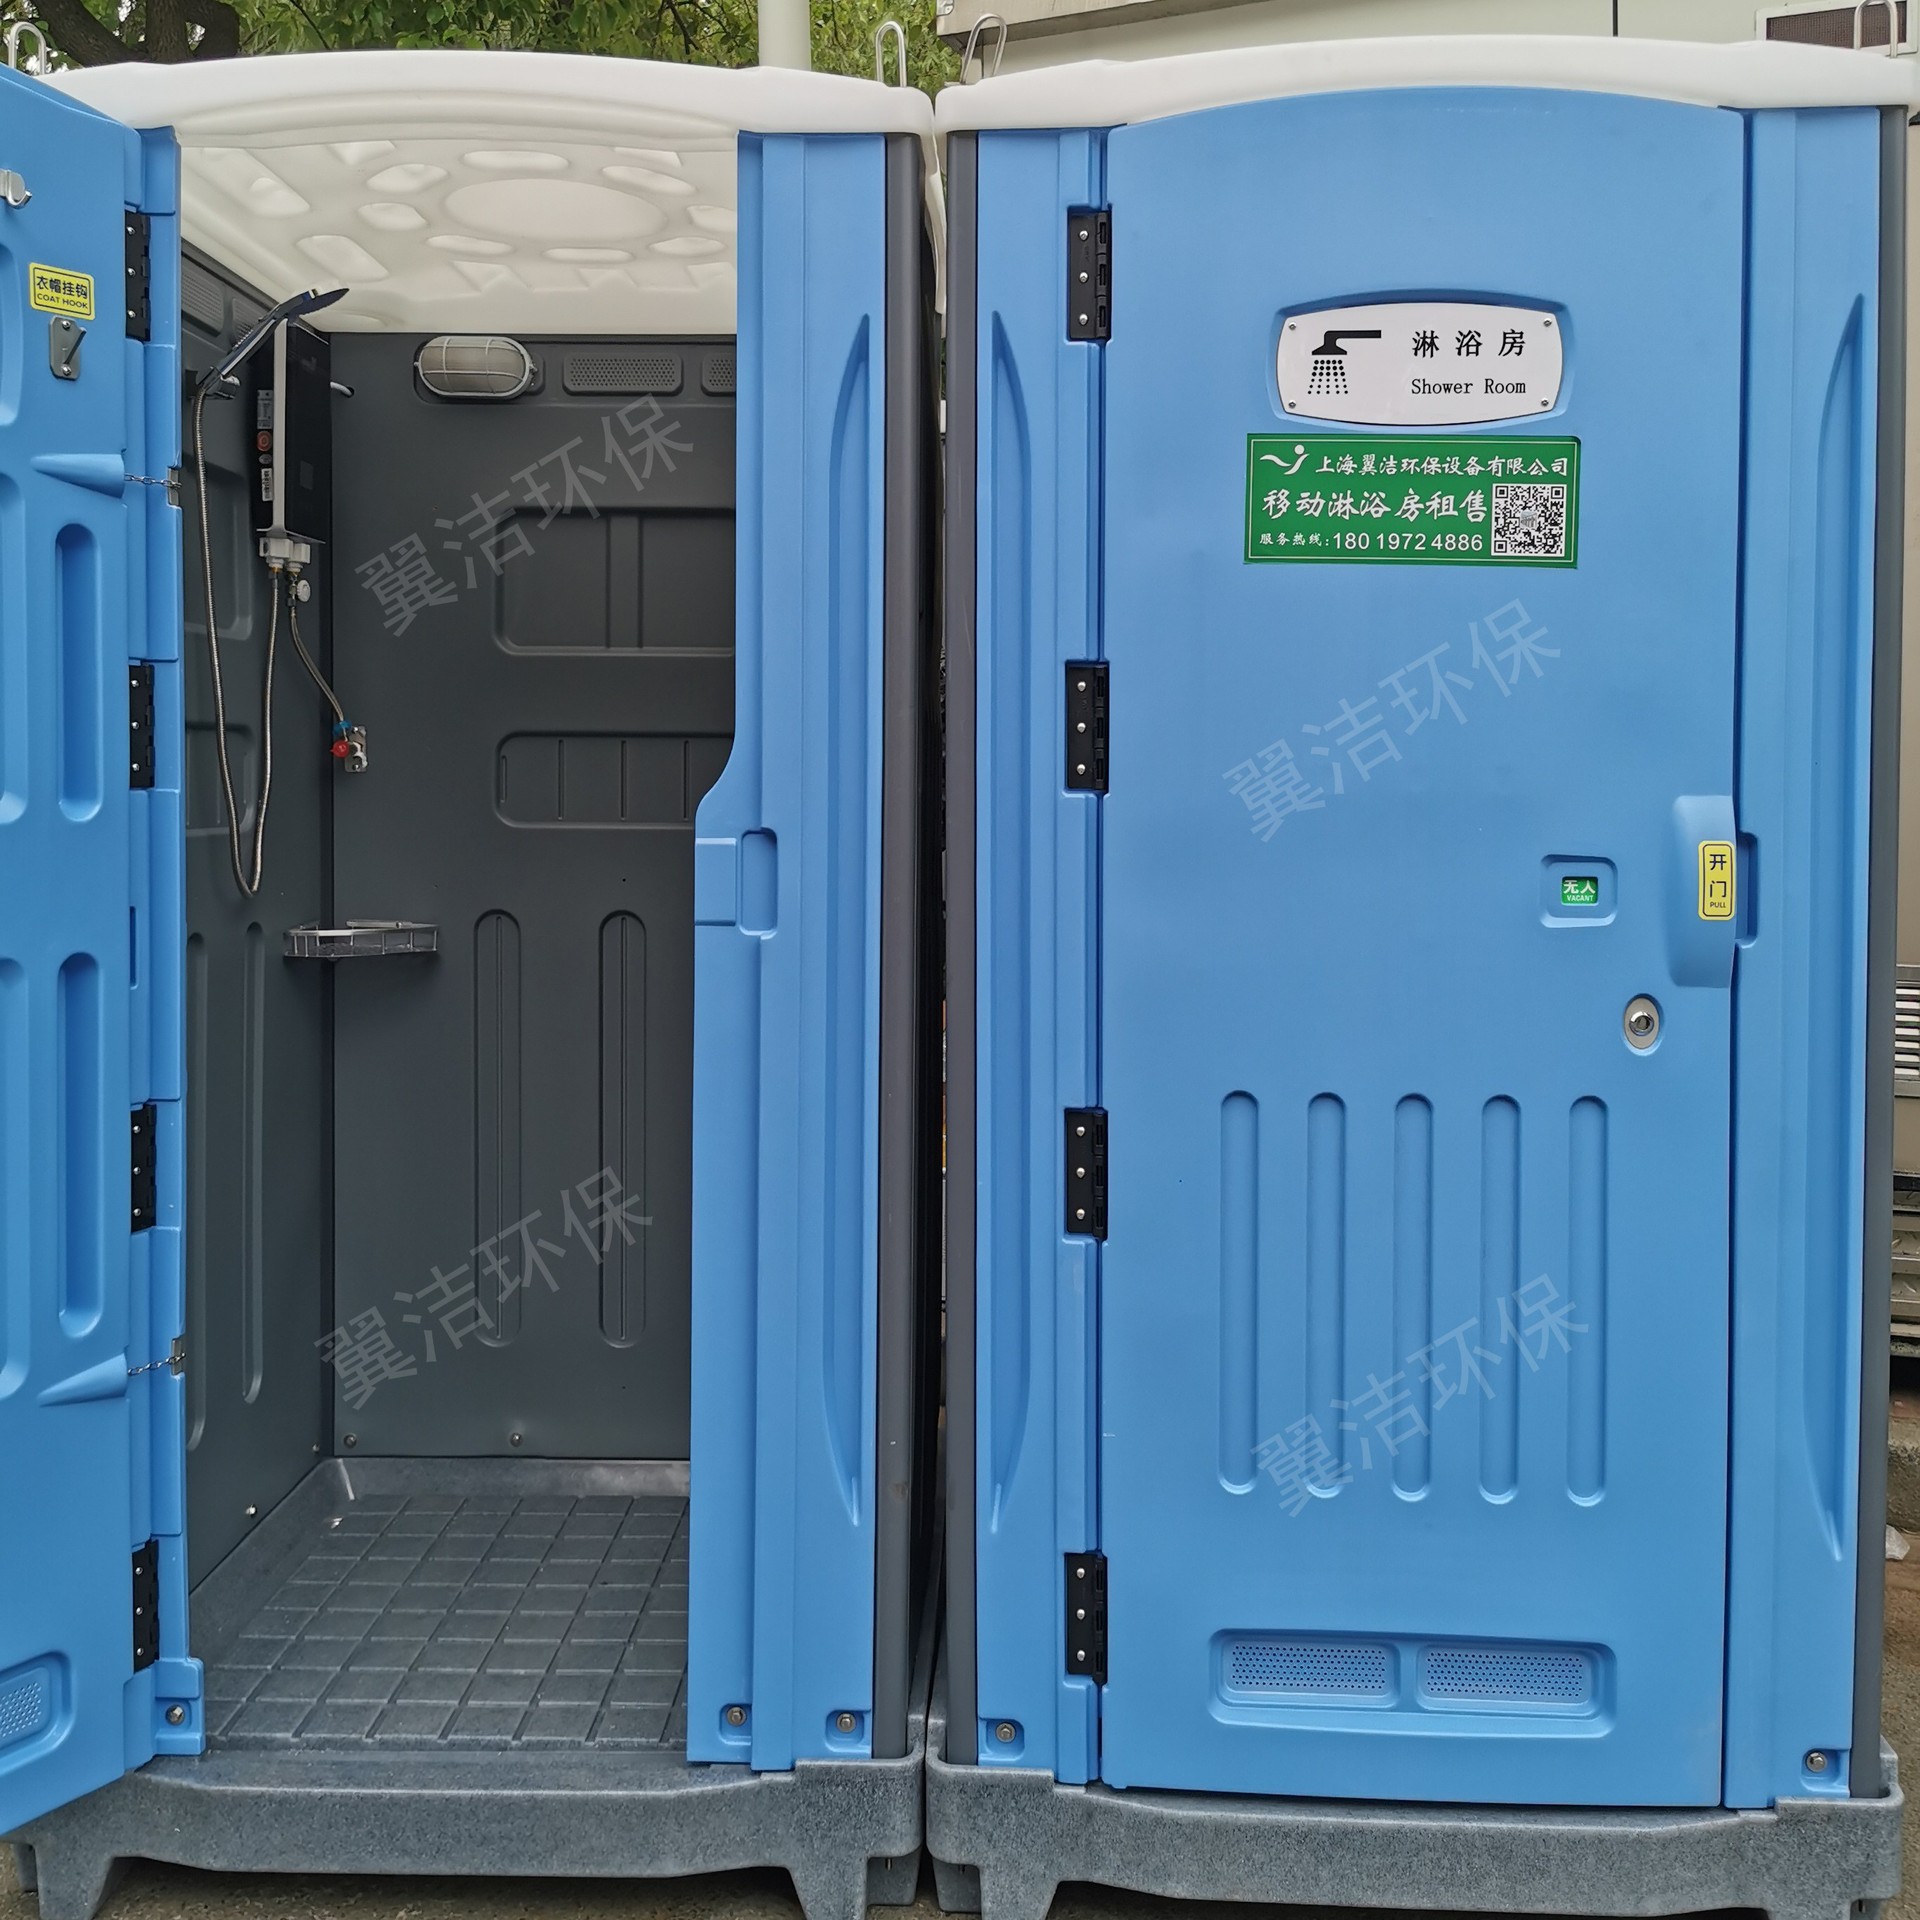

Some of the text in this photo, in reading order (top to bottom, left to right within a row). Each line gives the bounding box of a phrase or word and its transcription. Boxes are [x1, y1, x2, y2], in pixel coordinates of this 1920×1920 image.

[37, 275, 88, 298] 衣帽挂钩
[37, 293, 88, 309] COAT HOOK
[1411, 329, 1526, 359] 淋浴房
[1411, 378, 1526, 395] Shower Room
[1315, 453, 1568, 478] 上海翼洁环保设备有限公司
[1262, 488, 1488, 523] 移动淋浴房租售
[1709, 854, 1727, 898] 开门
[1563, 880, 1596, 894] 无人
[1567, 894, 1594, 902] VACANT
[1710, 901, 1726, 909] PULL
